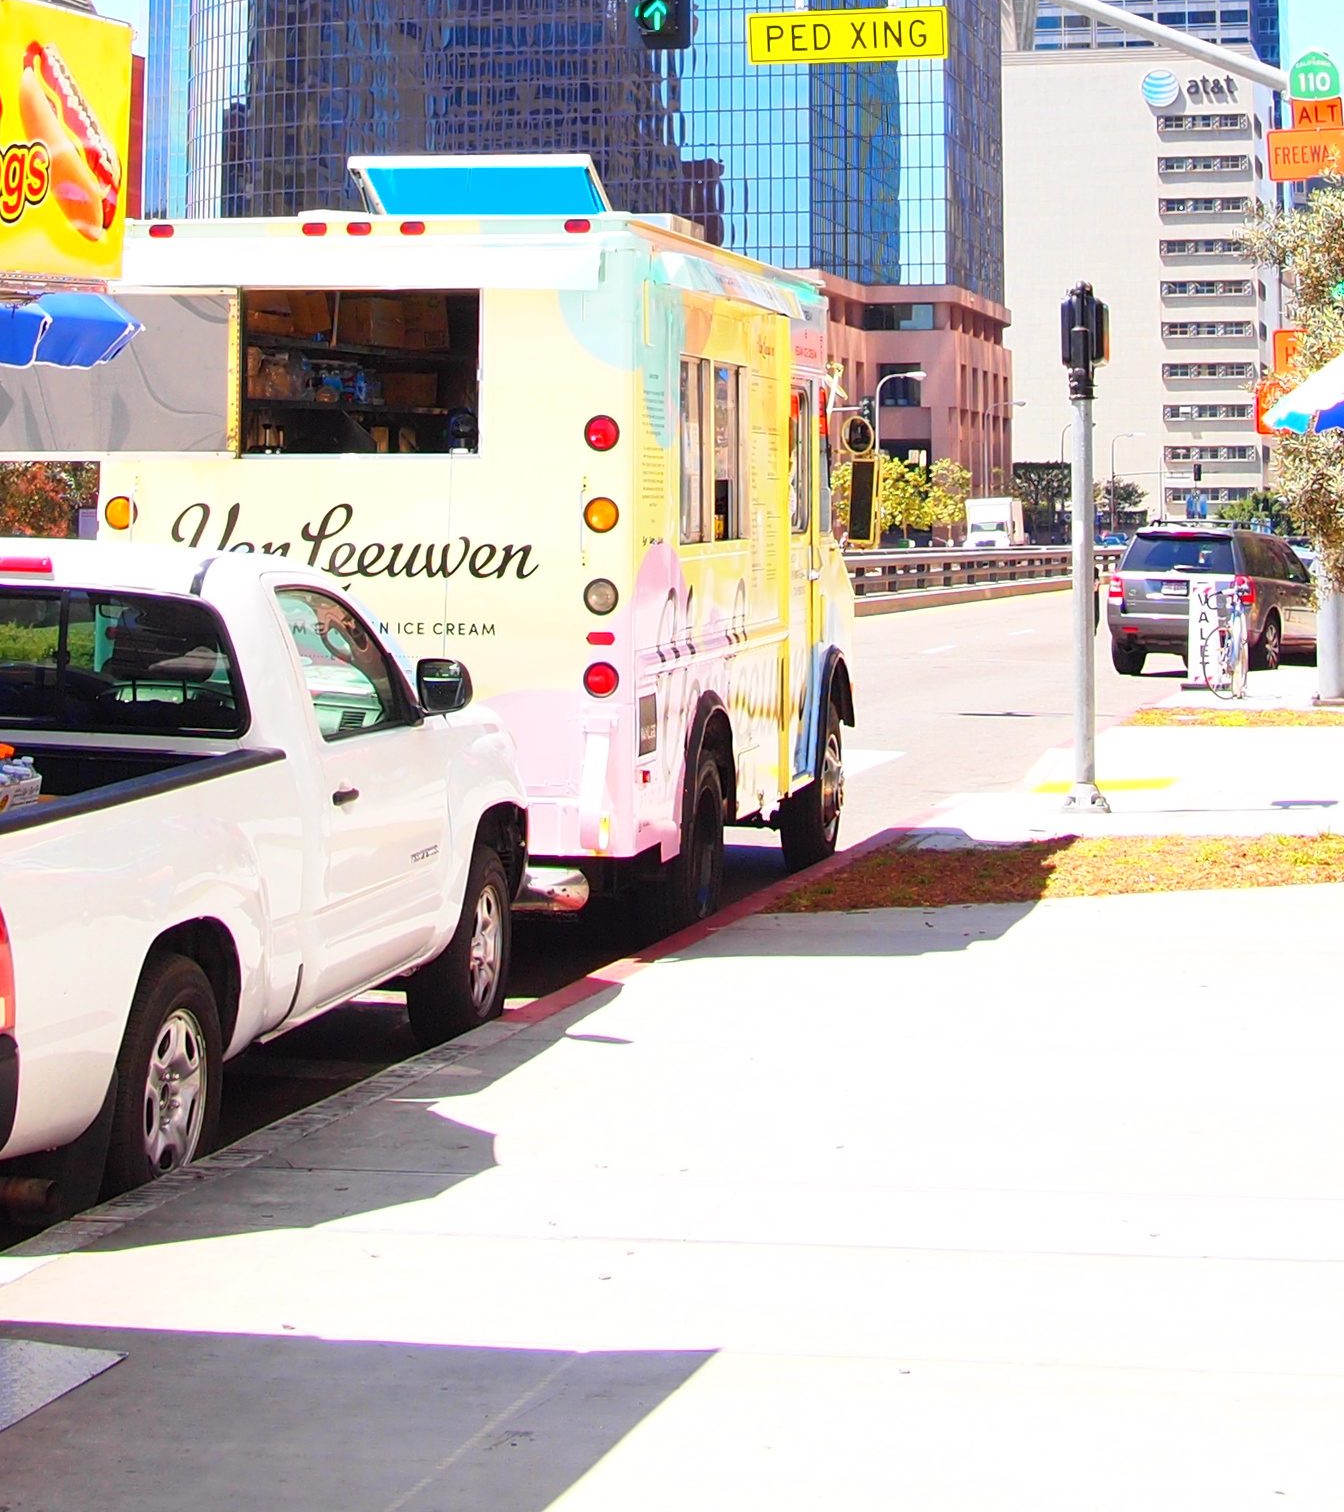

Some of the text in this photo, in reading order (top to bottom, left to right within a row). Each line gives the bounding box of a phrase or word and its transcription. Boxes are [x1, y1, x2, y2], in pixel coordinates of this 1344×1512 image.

[767, 19, 927, 53] PED XING
[1186, 74, 1236, 95] at&t
[1298, 72, 1331, 92] 110
[1298, 105, 1338, 124] ALT
[1274, 144, 1338, 165] FREEWA
[301, 503, 539, 583] Leeuwen
[397, 622, 425, 635] ICE
[432, 622, 496, 636] CREAM
[1197, 593, 1210, 665] VALET
